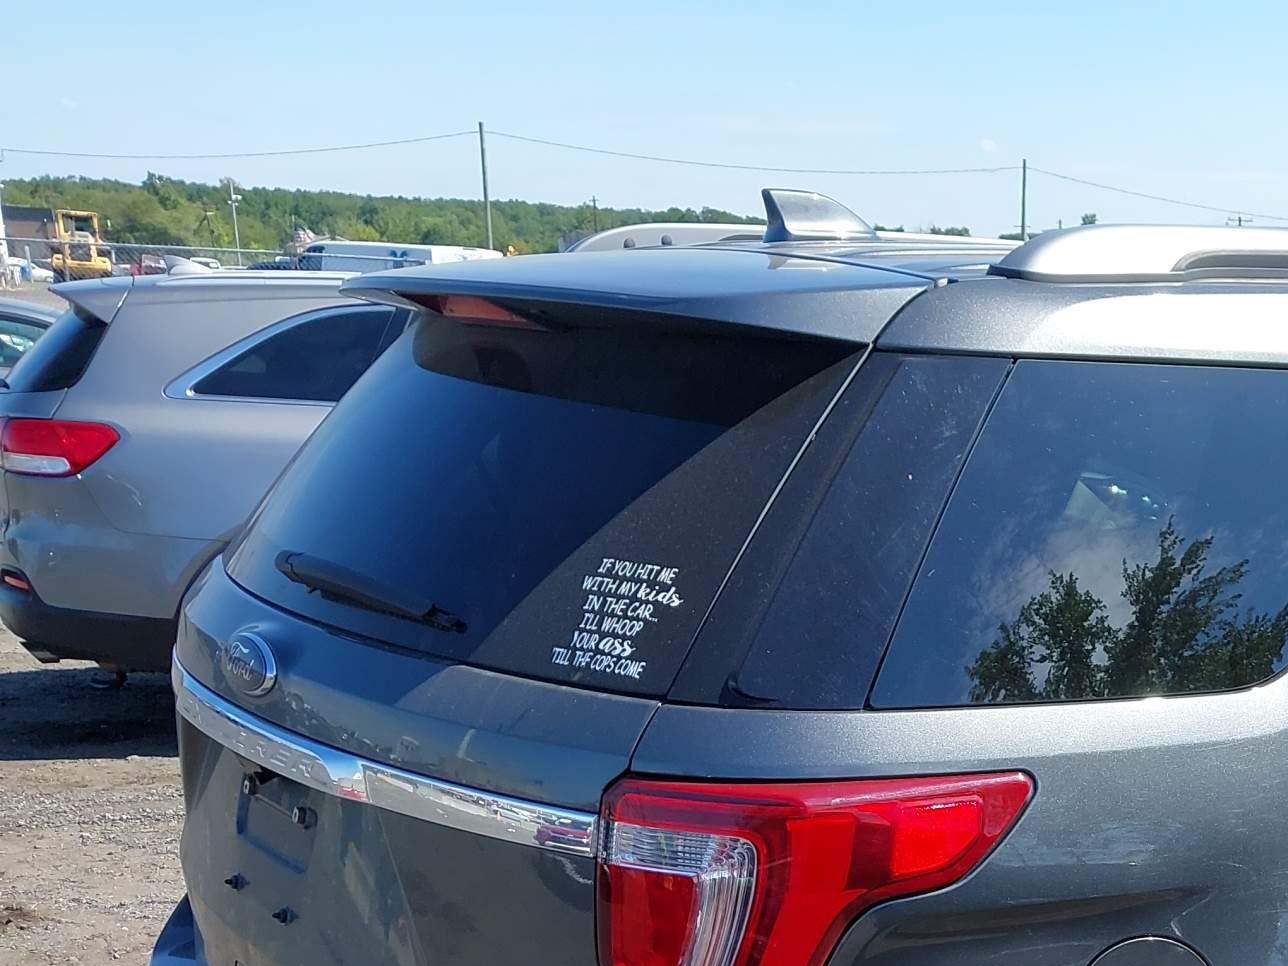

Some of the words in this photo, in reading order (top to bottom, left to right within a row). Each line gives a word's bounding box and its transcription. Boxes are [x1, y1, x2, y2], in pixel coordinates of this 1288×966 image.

[598, 559, 615, 574] IF
[612, 560, 638, 578] YOU
[634, 563, 660, 580] HIT
[657, 567, 679, 584] ME
[582, 576, 619, 594] WITH
[617, 581, 640, 597] MY
[637, 583, 684, 607] kids
[583, 595, 603, 611] IN
[604, 597, 630, 615] THE
[627, 602, 658, 622] CAR...
[579, 612, 600, 630] I'LL
[601, 616, 644, 636] WHOOP
[570, 631, 600, 650] YOUR
[598, 637, 636, 657] ass
[226, 641, 254, 681] Ford
[590, 655, 617, 673] COPS
[615, 658, 647, 679] COME
